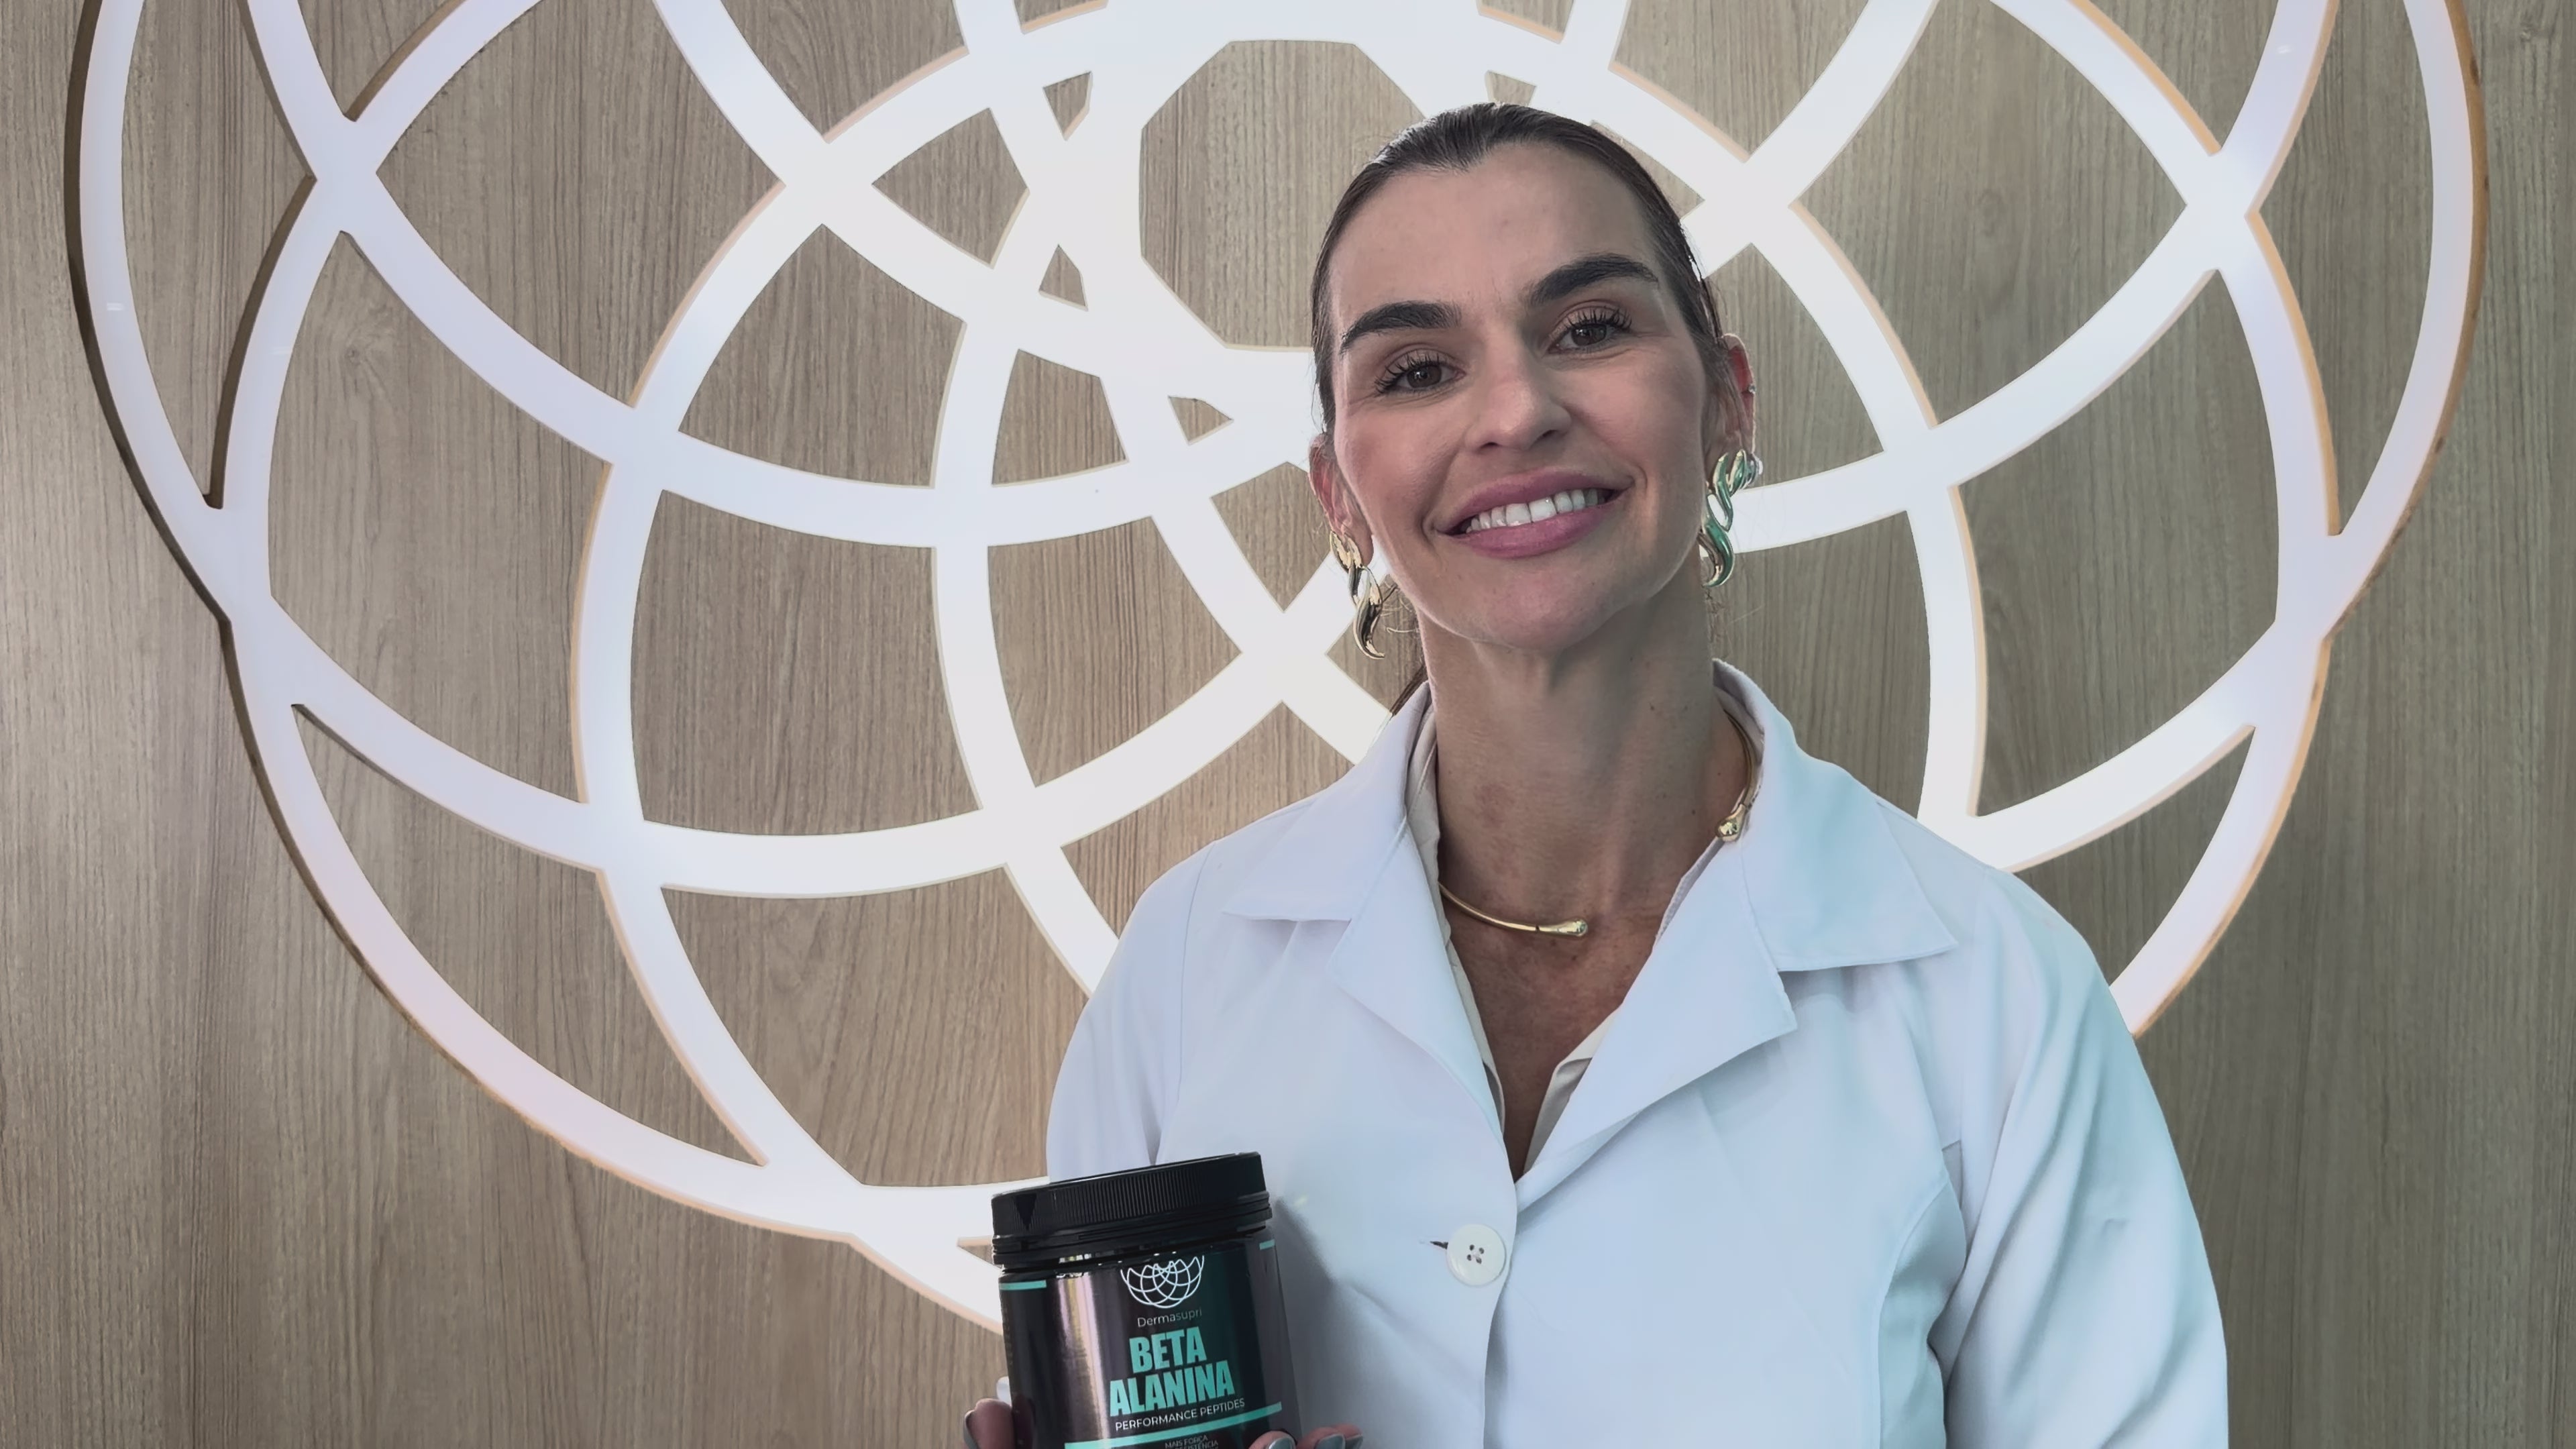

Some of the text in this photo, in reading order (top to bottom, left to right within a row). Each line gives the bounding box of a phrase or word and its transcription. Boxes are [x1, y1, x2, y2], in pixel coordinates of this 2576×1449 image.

[1137, 1307, 1202, 1328] Dermasupri
[1129, 1326, 1207, 1373] BETA
[1110, 1360, 1235, 1417] ALANINA
[1116, 1398, 1245, 1432] PERFORMANCE PEPTIDES
[1165, 1440, 1183, 1449] MAIS
